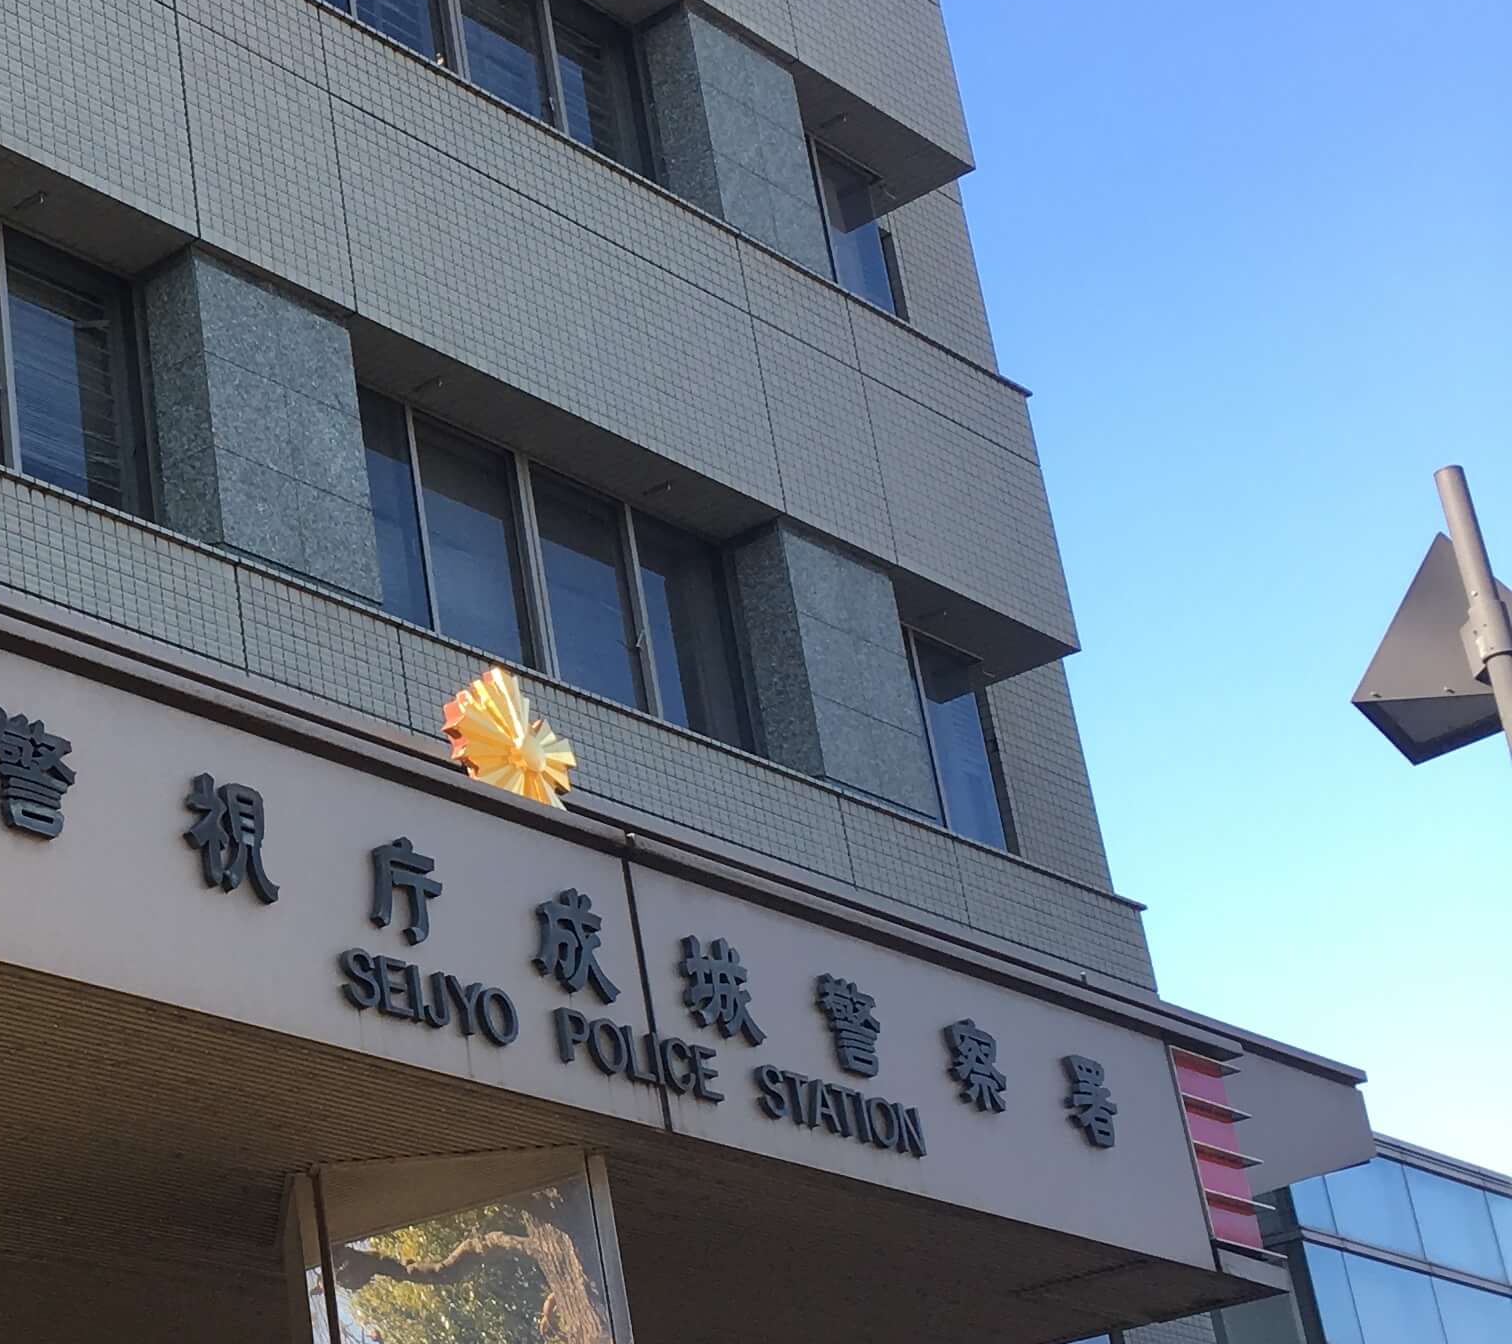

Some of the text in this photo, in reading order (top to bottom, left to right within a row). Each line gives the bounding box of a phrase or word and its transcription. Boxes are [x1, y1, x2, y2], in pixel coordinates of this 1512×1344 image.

[339, 948, 927, 1158] SEIJYO POLICE STATION
